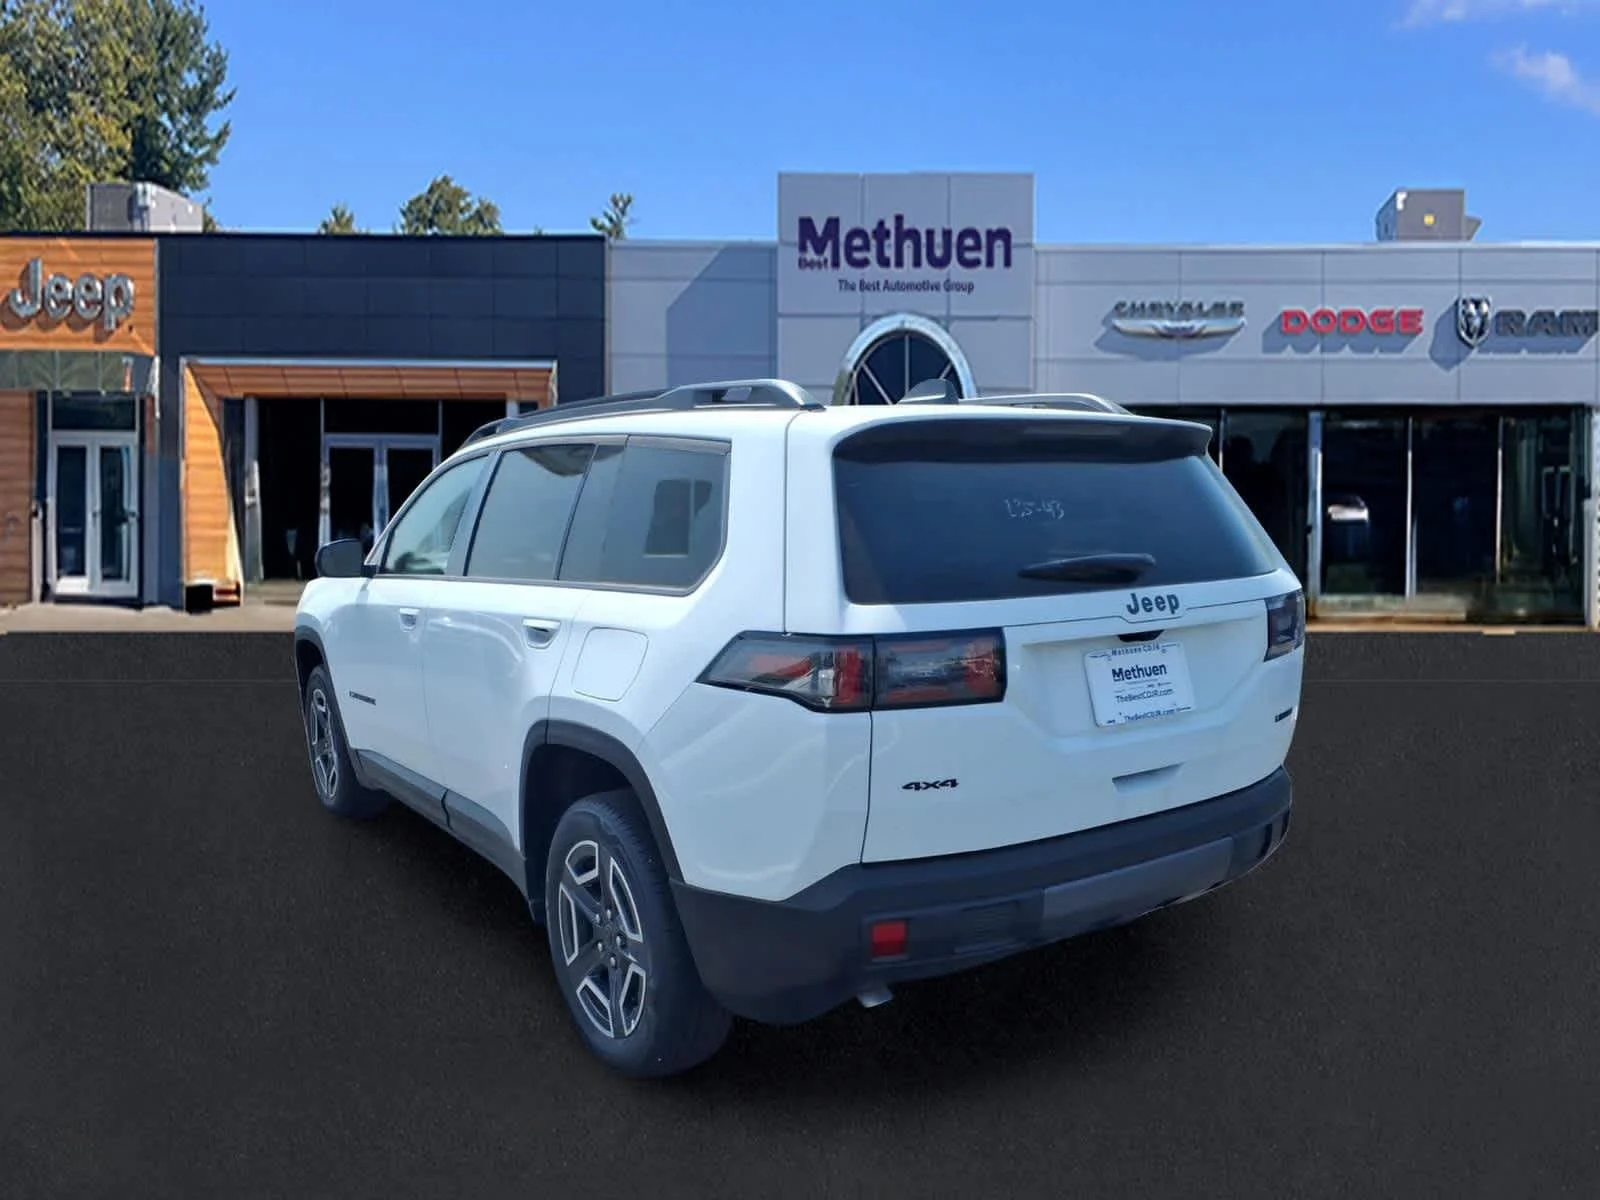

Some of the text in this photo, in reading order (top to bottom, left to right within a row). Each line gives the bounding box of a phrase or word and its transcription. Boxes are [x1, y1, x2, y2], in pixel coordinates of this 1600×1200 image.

[798, 214, 1012, 269] Methuen
[8, 257, 135, 331] Jeep
[838, 279, 975, 295] The Best Automotive Group
[1113, 301, 1245, 318] CHRYSLER
[1281, 308, 1424, 335] DODGE
[1495, 309, 1599, 337] RAM
[1126, 593, 1180, 615] Jeep
[1112, 664, 1167, 682] Methuen
